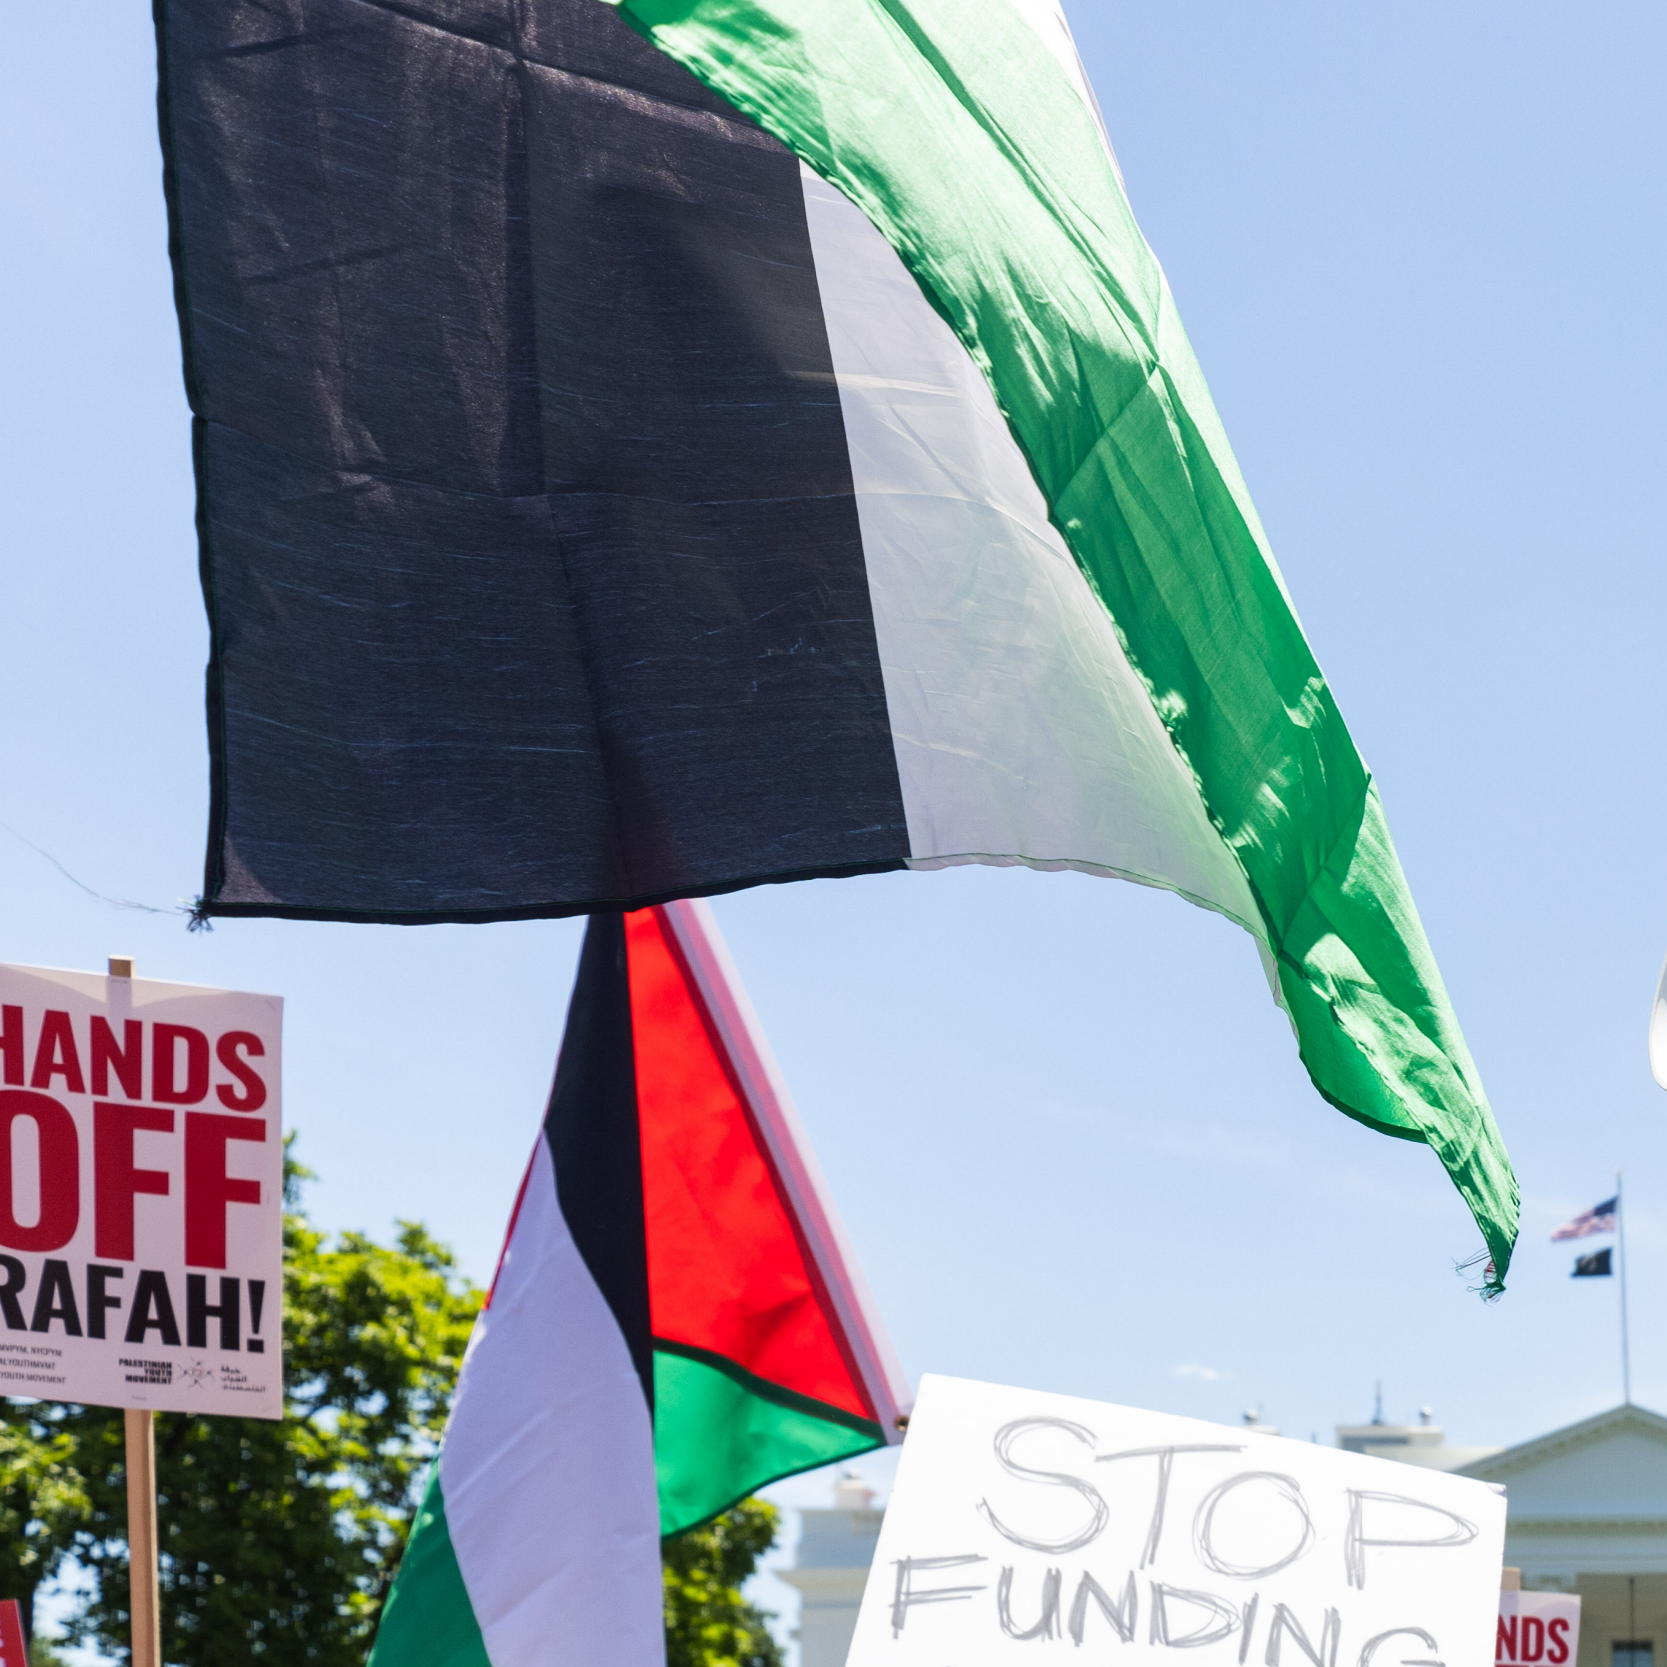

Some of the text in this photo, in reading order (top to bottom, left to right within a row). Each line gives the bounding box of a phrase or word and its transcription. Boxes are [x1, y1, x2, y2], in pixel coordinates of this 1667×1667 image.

[119, 1358, 172, 1370] PALESTINIAN
[144, 1368, 172, 1377] YOUTH
[125, 1375, 172, 1384] MOVEMENT
[977, 1416, 1478, 1591] STOP
